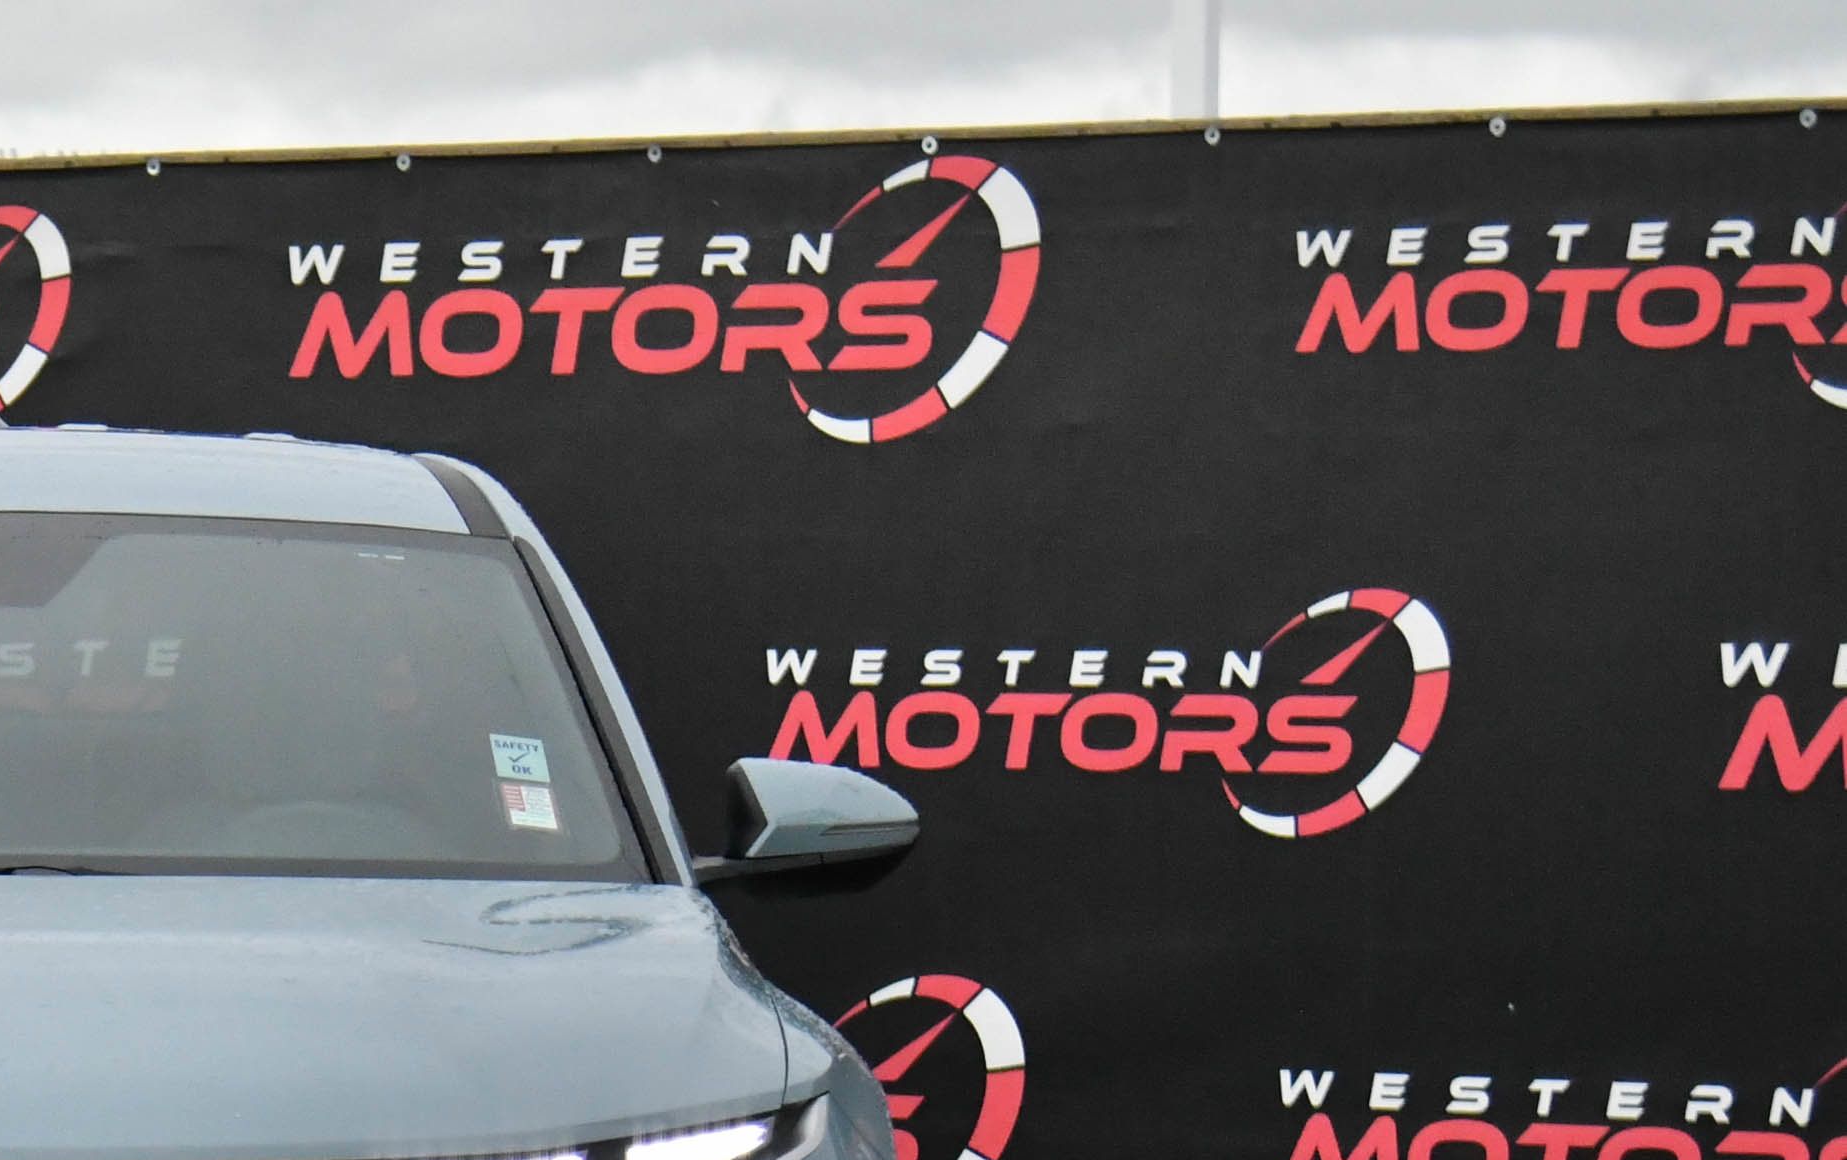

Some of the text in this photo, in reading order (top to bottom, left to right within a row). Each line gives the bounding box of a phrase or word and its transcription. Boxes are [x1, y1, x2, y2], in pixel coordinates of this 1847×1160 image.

[288, 232, 834, 285] WESTERN
[1296, 217, 1838, 267] WESTERN
[289, 279, 939, 379] MOTORS
[1295, 263, 1847, 353] MOTOR
[766, 648, 1262, 688] WESTERN
[494, 739, 539, 752] SAFETY
[768, 690, 1357, 774] MOTORS
[512, 765, 533, 775] OK
[1279, 1069, 1815, 1126] WESTERN
